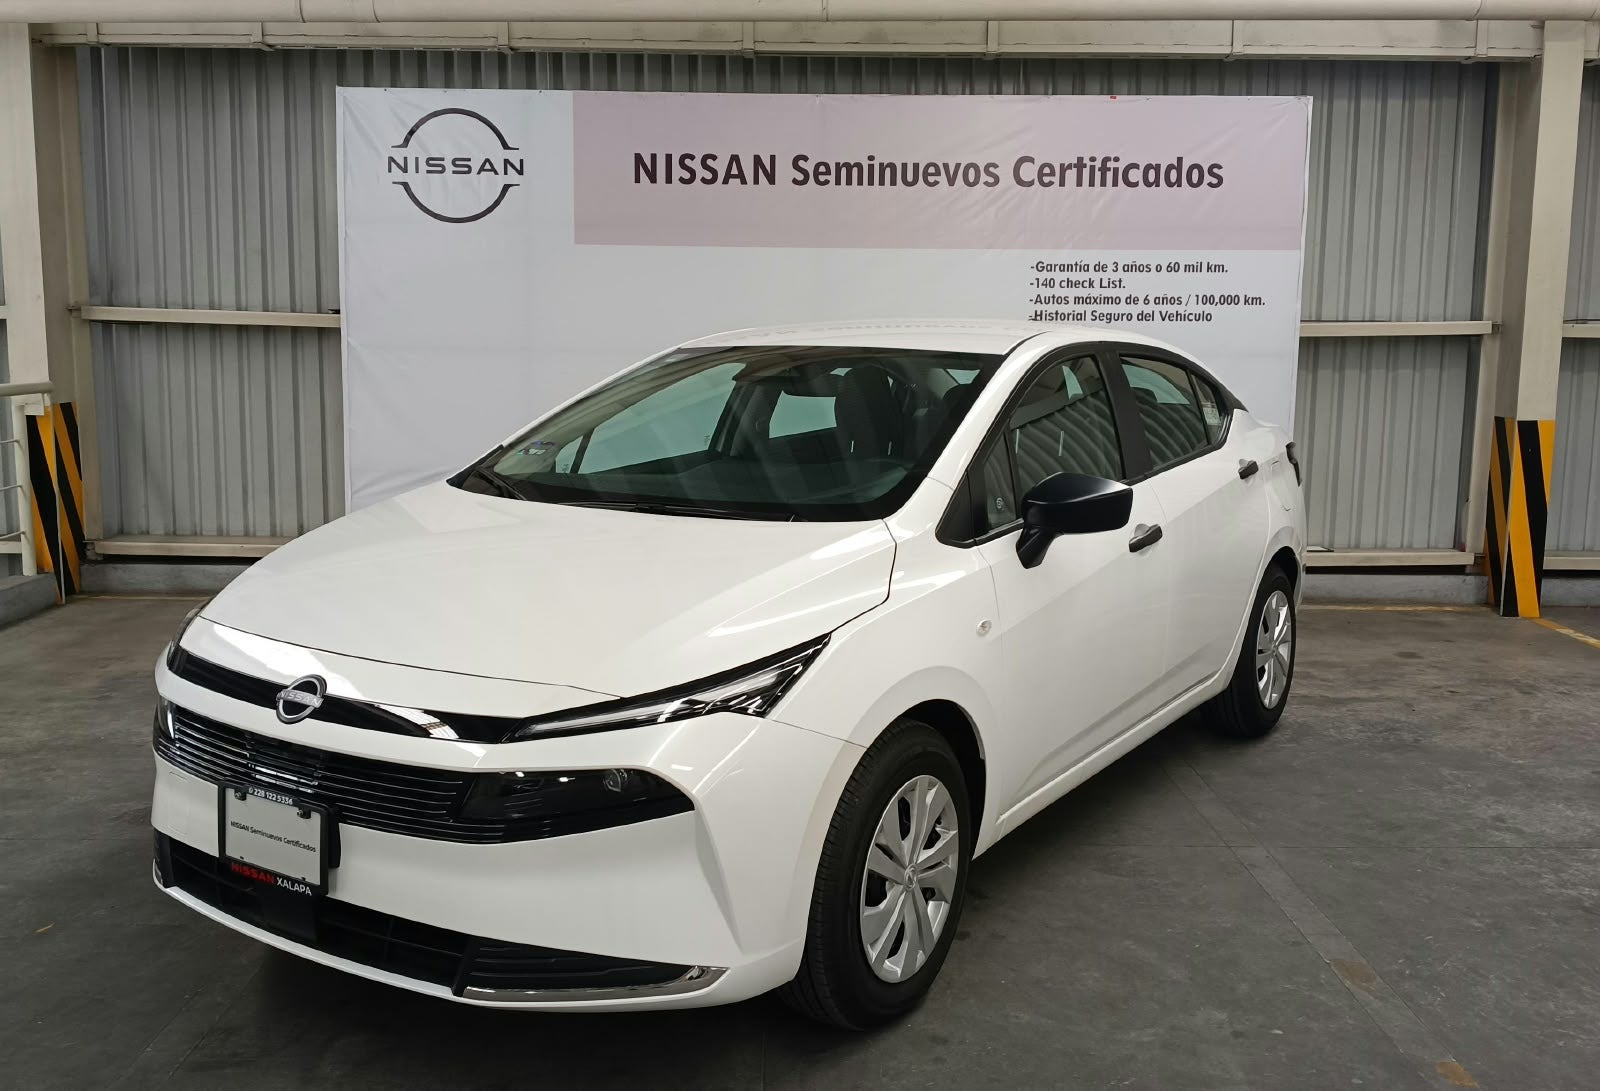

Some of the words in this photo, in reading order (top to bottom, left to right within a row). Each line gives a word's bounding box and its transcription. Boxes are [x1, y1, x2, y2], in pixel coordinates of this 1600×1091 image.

[387, 155, 524, 176] NISSAN
[633, 152, 777, 186] NISSAN
[792, 153, 1000, 188] Seminuevos
[1012, 155, 1224, 189] Certificados
[1030, 260, 1090, 273] -Garantía
[1094, 260, 1109, 273] de
[1112, 261, 1119, 273] 3
[1122, 260, 1152, 273] años
[1155, 264, 1163, 273] o
[1166, 261, 1181, 273] 60
[1184, 261, 1203, 273] mil
[1206, 262, 1229, 273] km.
[1029, 277, 1056, 289] -140
[1059, 277, 1096, 289] check
[1099, 277, 1126, 289] List.
[1029, 293, 1070, 305] -Autos
[1073, 292, 1122, 305] máximo
[1125, 293, 1140, 305] de
[1143, 294, 1150, 305] 6
[1153, 293, 1183, 306] años
[1185, 294, 1191, 307] /
[1194, 294, 1241, 307] 100,000
[1243, 294, 1266, 306] km.
[1090, 310, 1133, 324] Seguro
[1136, 310, 1155, 322] del
[1159, 309, 1213, 322] Vehículo
[266, 791, 277, 801] 122
[230, 820, 250, 832] NISSAN
[250, 826, 283, 843] Seminuevos
[283, 837, 317, 853] Certificados
[230, 862, 275, 884] NISSAN
[276, 877, 313, 896] XALAPA
